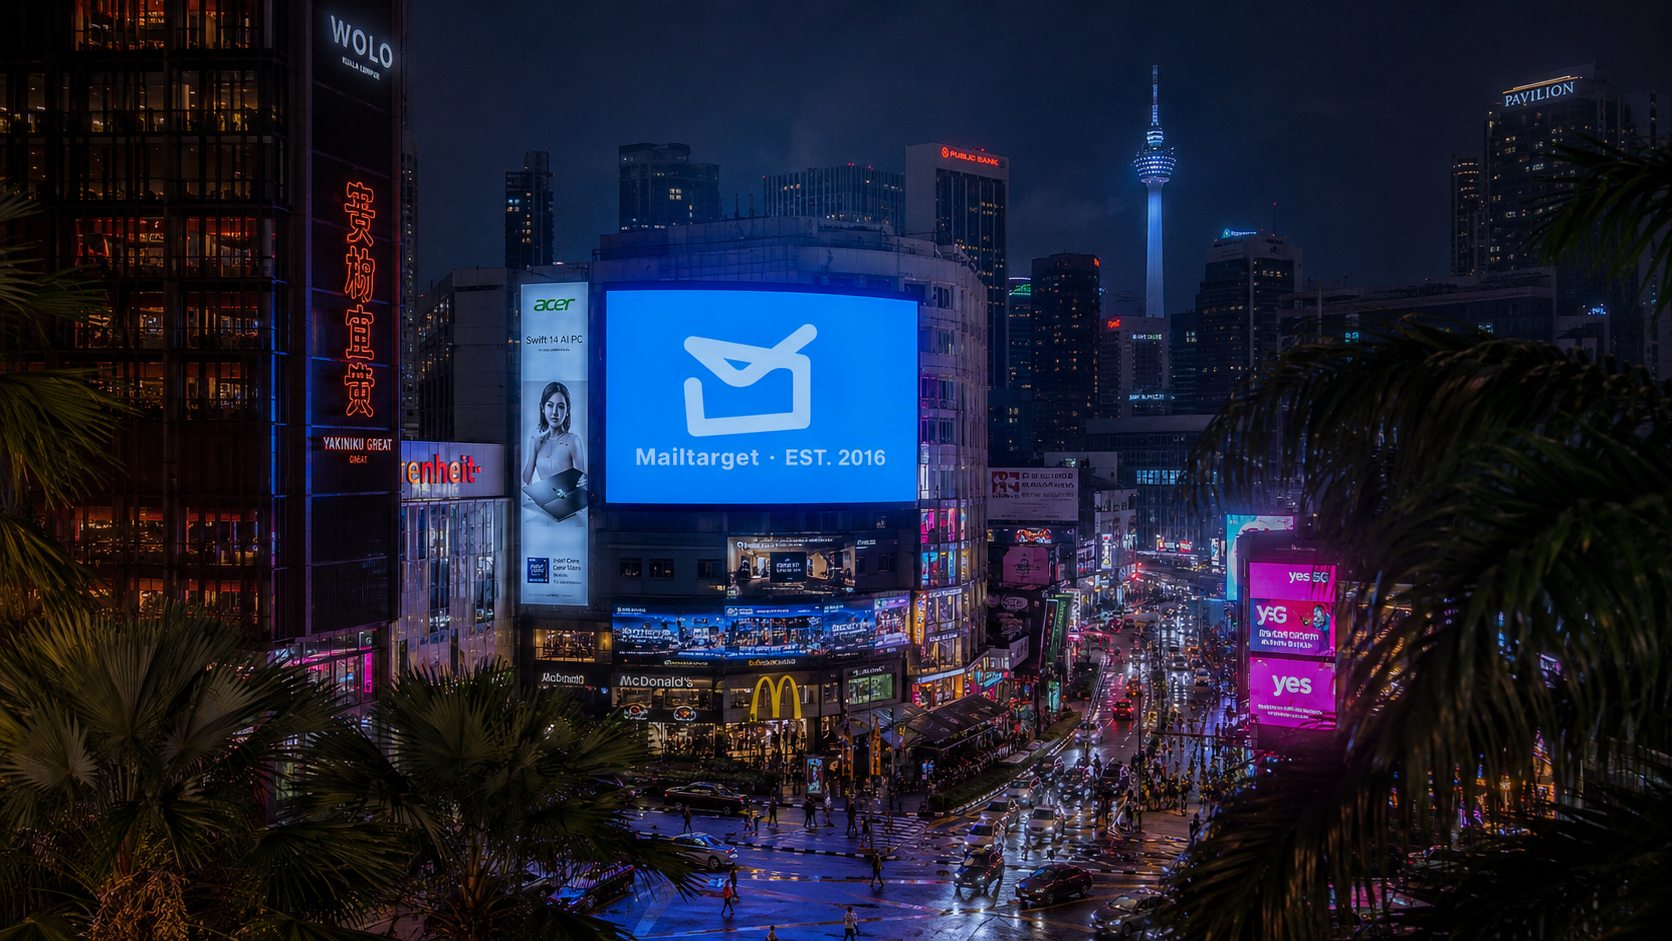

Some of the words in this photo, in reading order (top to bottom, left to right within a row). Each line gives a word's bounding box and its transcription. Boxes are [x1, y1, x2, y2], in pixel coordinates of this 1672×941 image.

[330, 14, 393, 69] WOLO
[1505, 81, 1575, 107] PAVILION
[950, 150, 976, 162] PUBLIC
[977, 156, 999, 167] BANK
[533, 298, 576, 312] acer
[526, 335, 548, 345] Swift
[549, 335, 559, 344] 14
[560, 335, 570, 344] AI
[571, 334, 584, 344] PC
[323, 436, 365, 451] YAKINIKU
[366, 437, 393, 451] GREAT
[635, 447, 760, 471] Mailtarget
[785, 448, 832, 466] EST.
[838, 448, 887, 466] 2016
[1288, 571, 1311, 584] yes
[1312, 571, 1329, 583] 5G
[620, 675, 693, 688] McDonald's
[1271, 674, 1312, 697] yes
